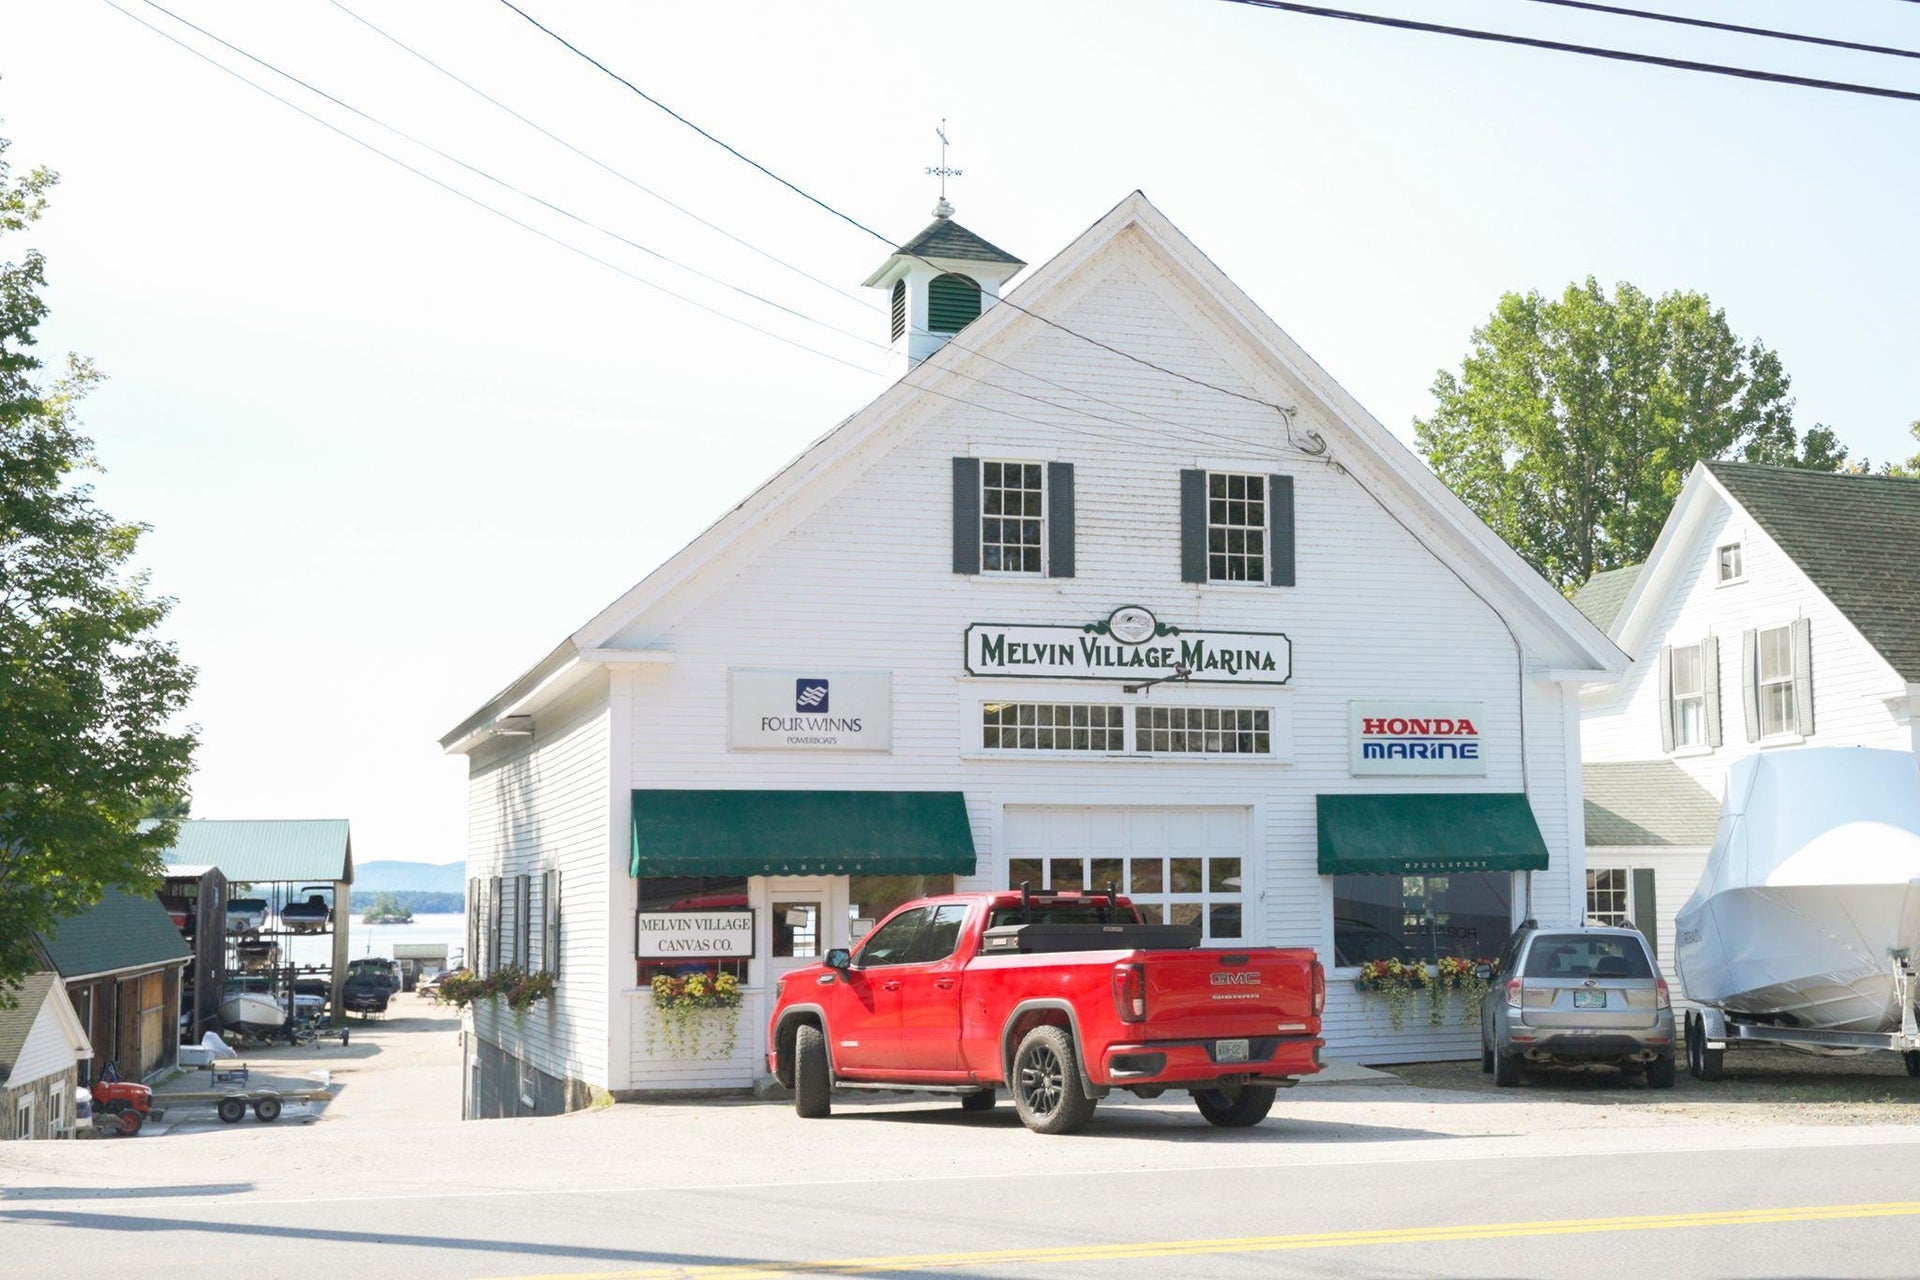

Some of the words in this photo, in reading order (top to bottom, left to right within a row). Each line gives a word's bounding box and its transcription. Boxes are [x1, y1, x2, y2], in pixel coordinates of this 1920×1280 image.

[981, 634, 1074, 667] MELVIN
[1079, 637, 1176, 668] VILLAGE
[1181, 640, 1276, 675] MARINA
[761, 717, 805, 731] FOUR
[806, 718, 862, 732] WINNS
[1362, 718, 1478, 735] HONDA
[787, 736, 837, 744] POWERBOATS
[1405, 861, 1487, 869] UPHOLSTERY
[641, 919, 692, 931] MELVIN
[695, 918, 751, 931] VILLAGE
[658, 939, 710, 951] CANVAS
[712, 939, 733, 951] CO.
[1211, 972, 1261, 985] GMC
